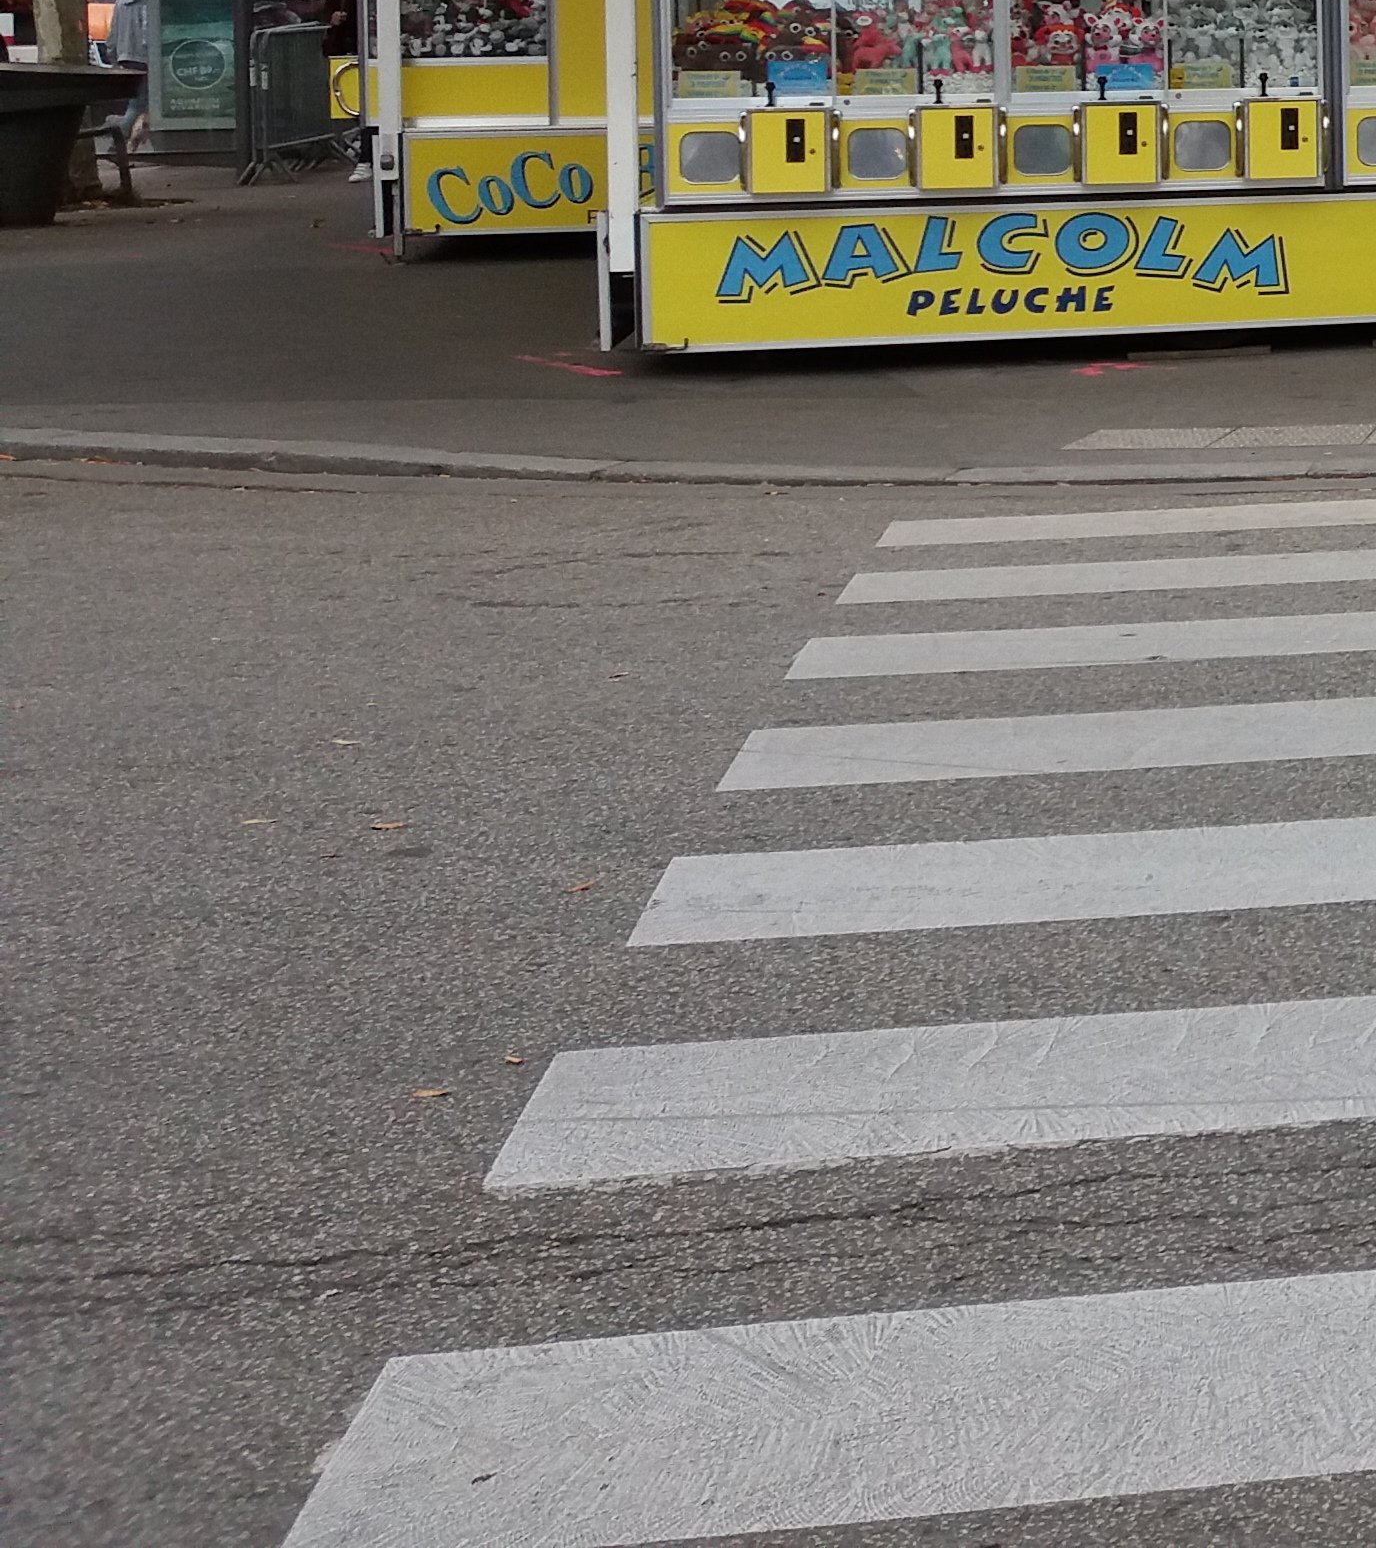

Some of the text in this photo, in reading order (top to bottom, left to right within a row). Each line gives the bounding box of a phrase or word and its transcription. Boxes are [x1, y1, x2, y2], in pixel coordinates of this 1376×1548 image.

[427, 150, 594, 225] CoCo
[714, 211, 1290, 305] MALCOLM
[906, 285, 1115, 317] PELUCHE
